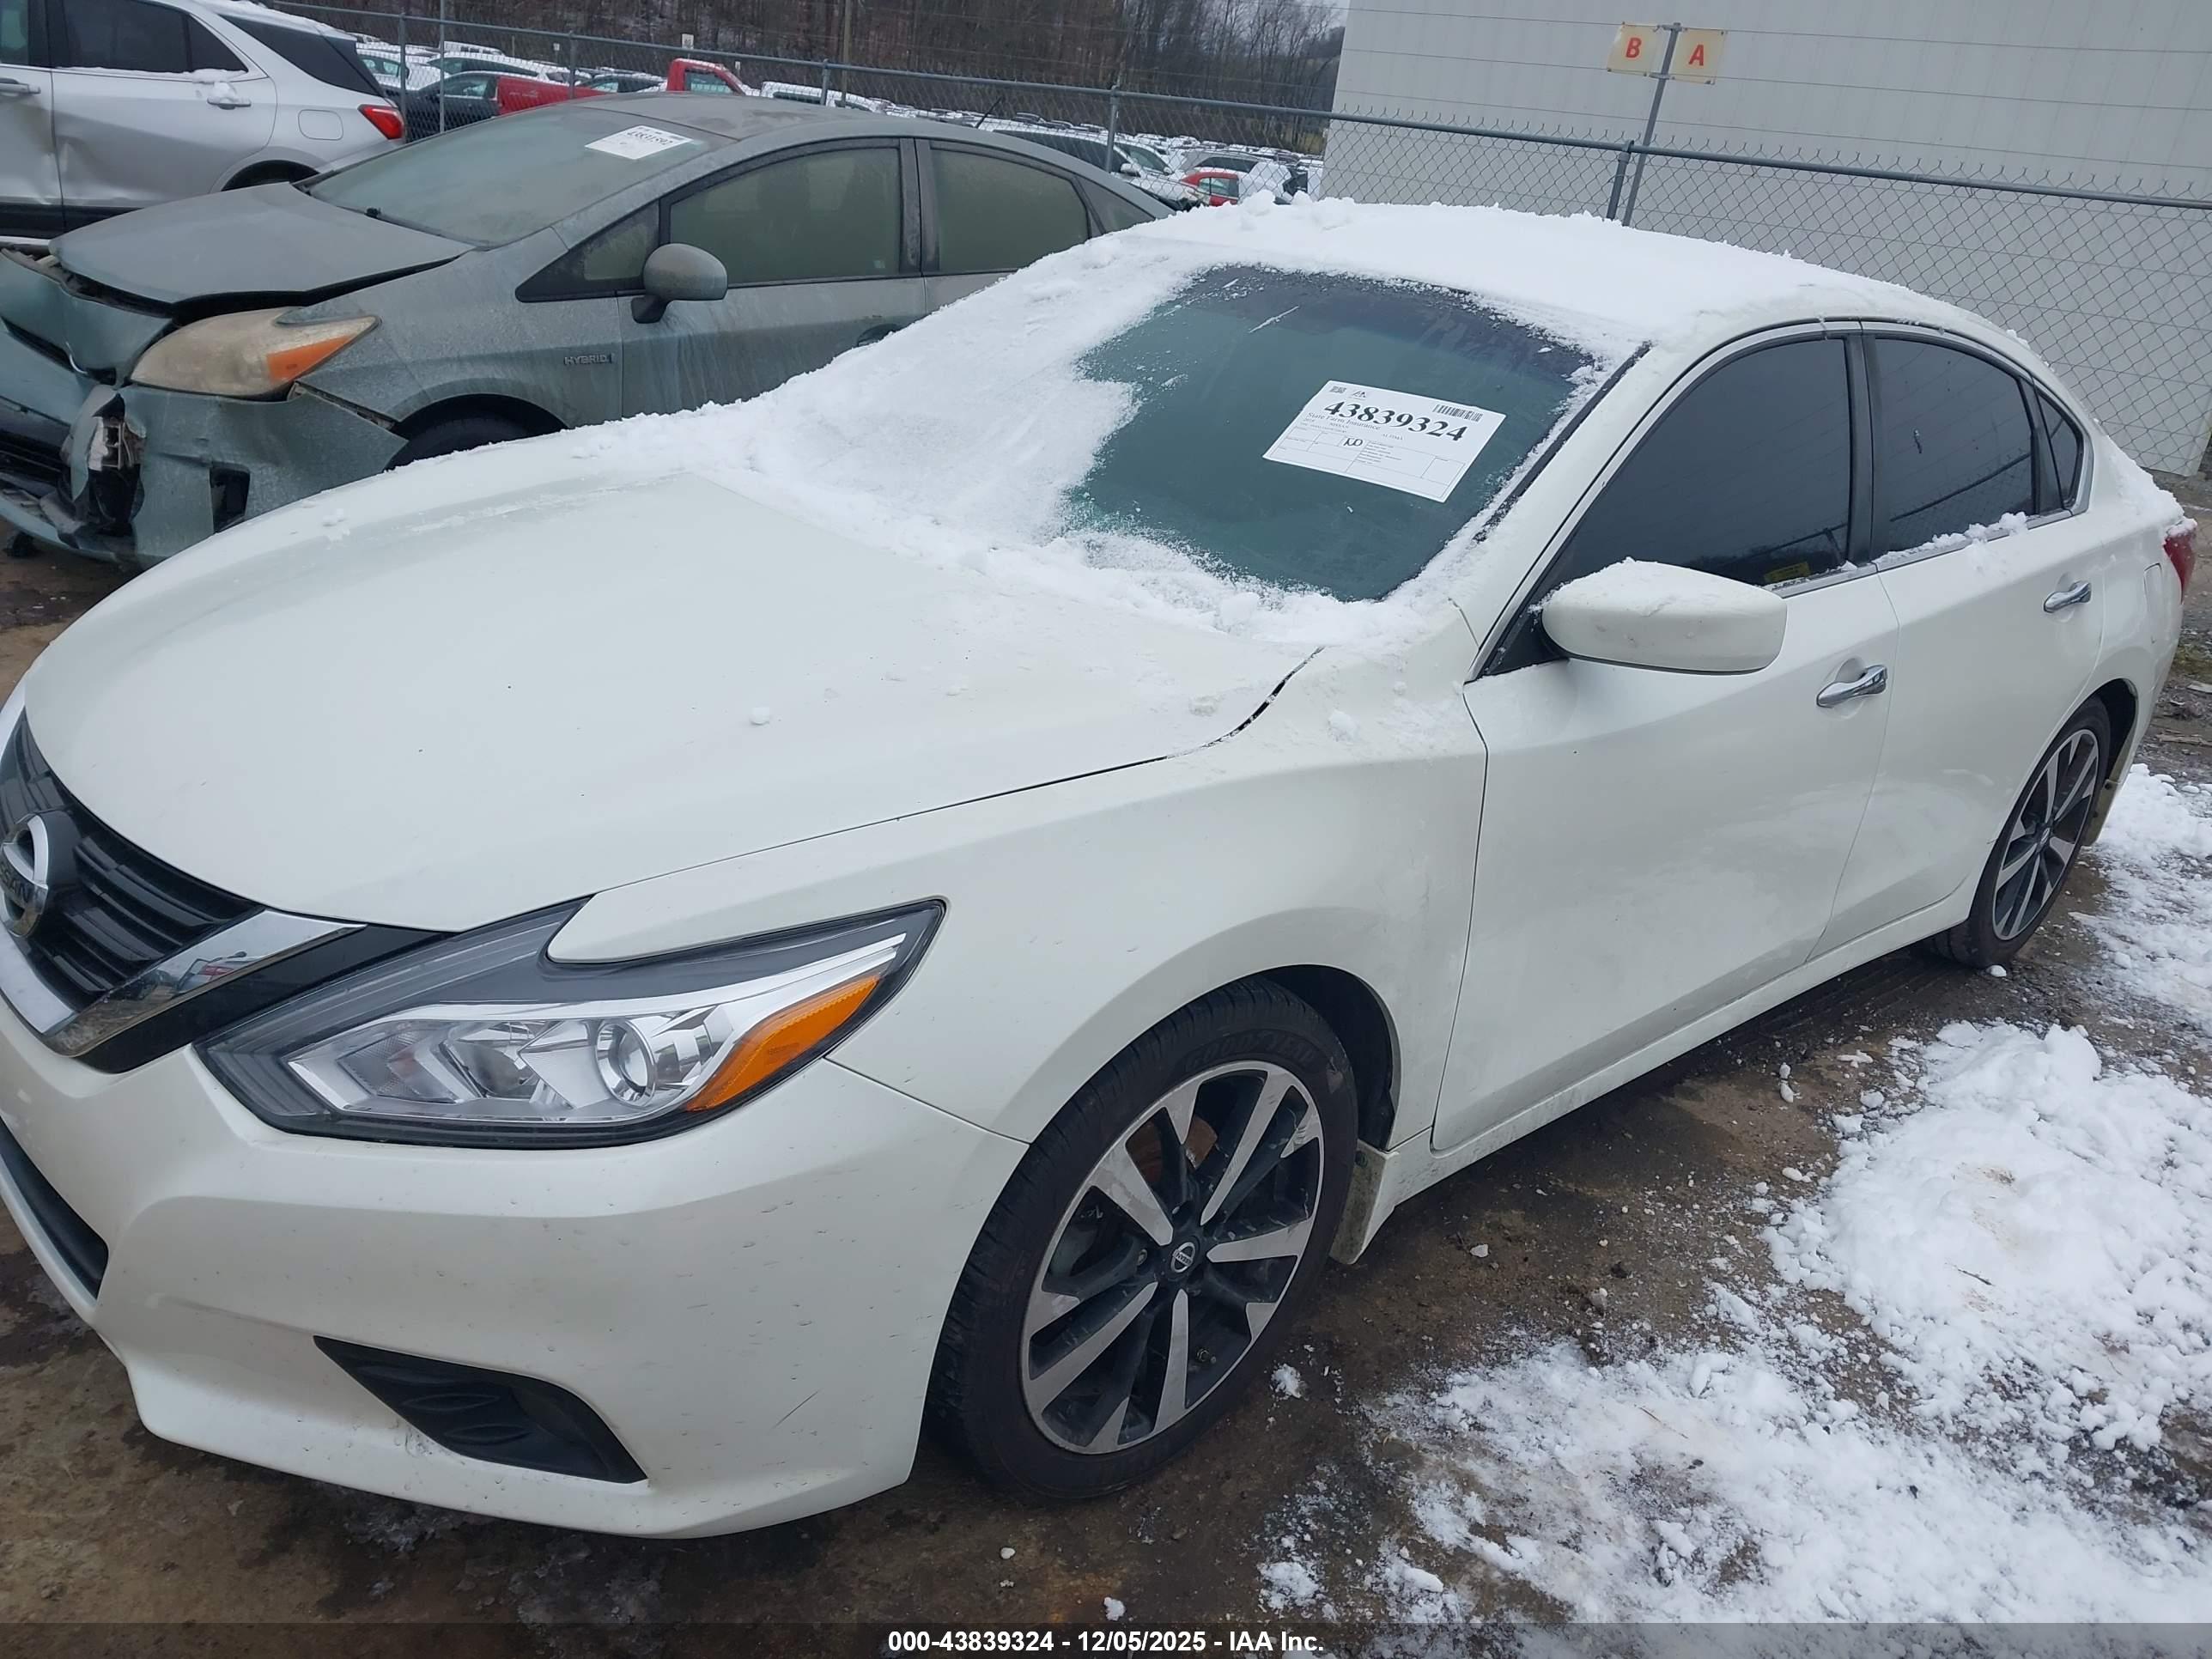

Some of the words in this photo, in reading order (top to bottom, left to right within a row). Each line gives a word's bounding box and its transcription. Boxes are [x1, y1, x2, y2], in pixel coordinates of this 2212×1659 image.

[1626, 37, 1642, 58] B
[1688, 44, 1705, 66] A
[564, 354, 607, 365] HYBRID
[1324, 401, 1468, 441] 43839324
[1327, 415, 1345, 423] Farm
[1346, 418, 1381, 430] Insurance
